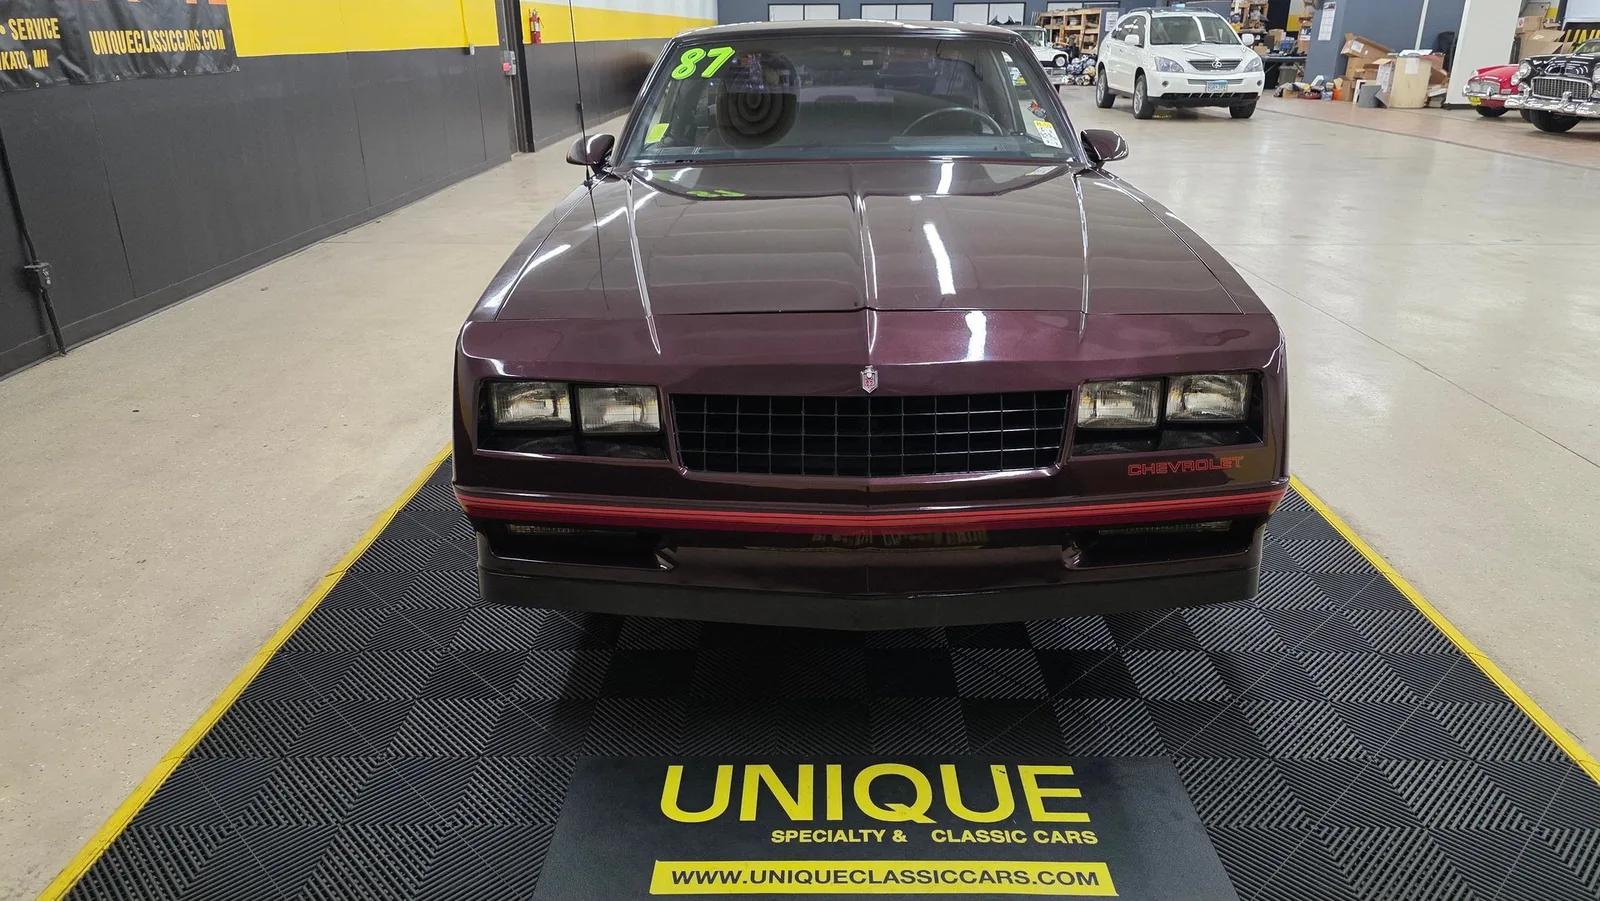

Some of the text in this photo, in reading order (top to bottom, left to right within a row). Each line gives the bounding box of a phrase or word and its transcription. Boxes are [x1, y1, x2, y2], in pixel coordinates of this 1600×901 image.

[8, 17, 61, 40] SERVICE
[89, 29, 226, 55] UNIQUECLASSICCARS.COM
[32, 49, 49, 68] MN
[671, 46, 736, 80] 87
[1127, 456, 1244, 476] CHEVROLET
[660, 763, 1091, 824] UNIQUE
[771, 829, 1099, 845] SPECIALTY & CLASSIC CARS
[671, 869, 1100, 886] WWW.UNIQUECLASSICCARS.COM
